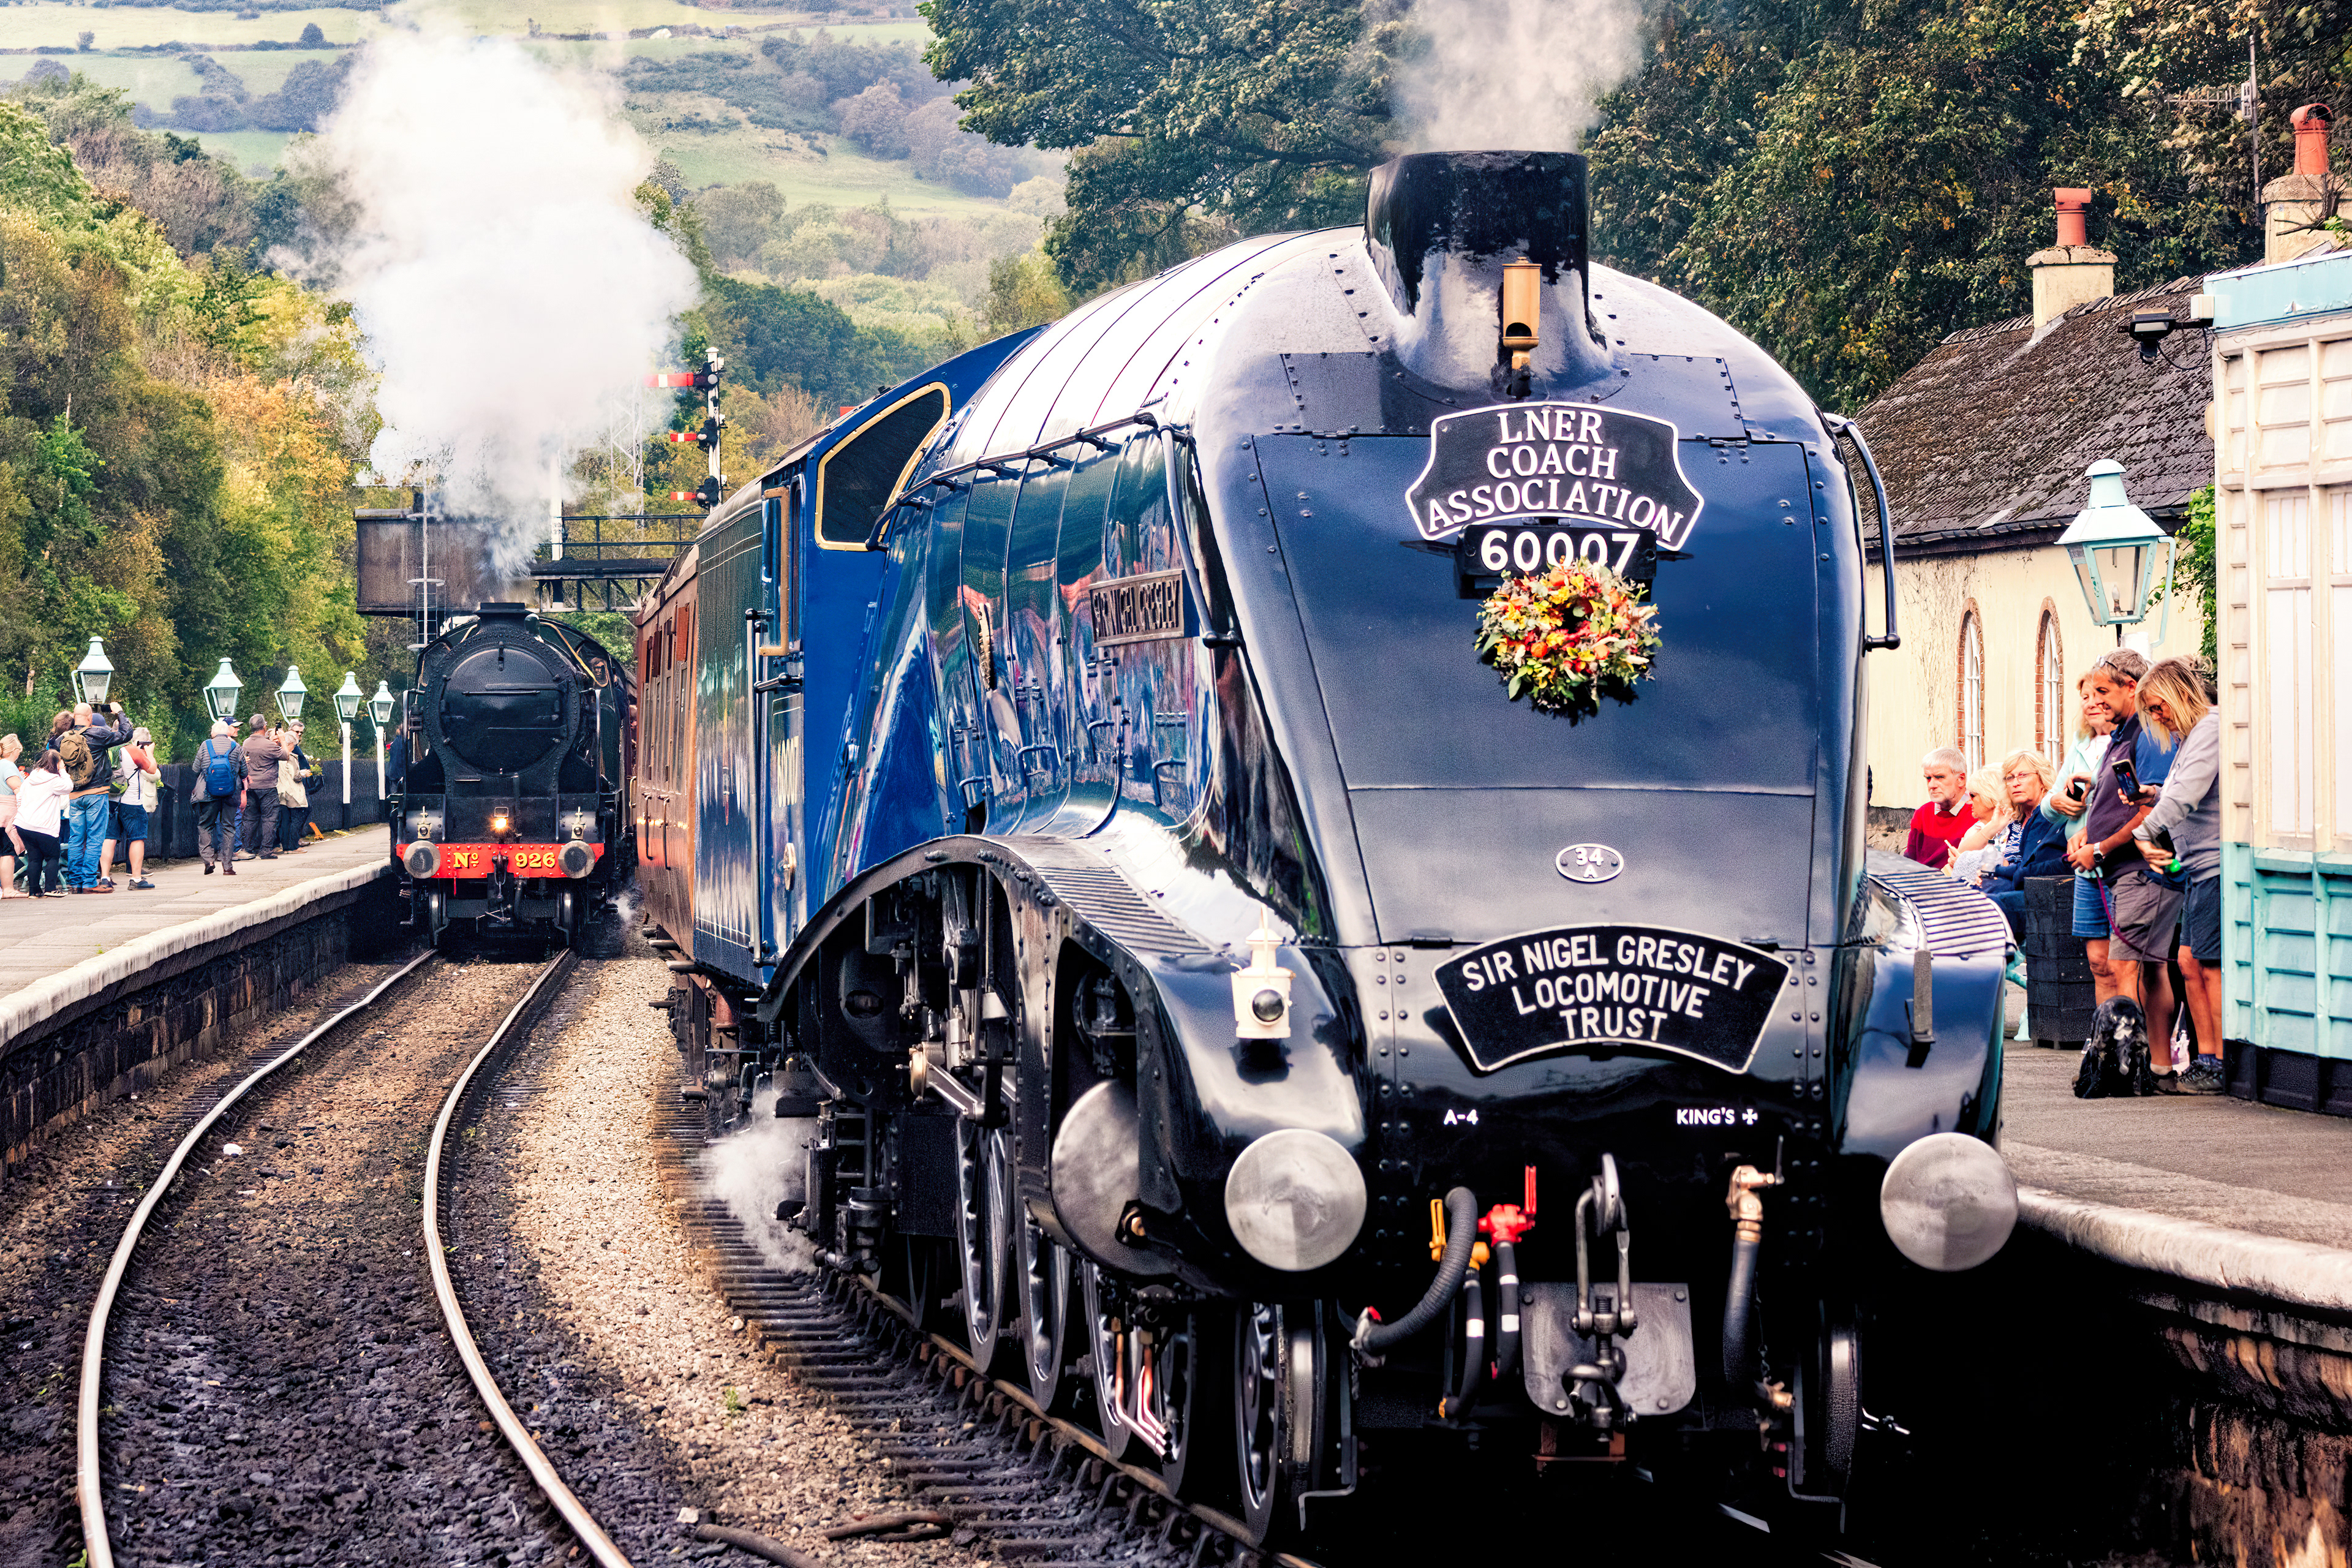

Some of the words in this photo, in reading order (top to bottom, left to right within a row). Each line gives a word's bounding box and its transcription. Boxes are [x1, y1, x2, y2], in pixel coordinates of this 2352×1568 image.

[1497, 409, 1604, 445] LNER
[1487, 443, 1618, 480] COACH
[1428, 479, 1684, 542] ASSOCIATION
[1480, 530, 1640, 574] 60007
[777, 735, 799, 808] 60007
[514, 853, 556, 869] 926
[1575, 847, 1604, 866] 34
[1583, 864, 1598, 878] A
[1463, 951, 1518, 992] SIR
[1521, 935, 1608, 975] NIGEL
[1617, 935, 1755, 991] GRESLEY
[1511, 971, 1710, 1019] LOCOMOTIVE
[1559, 1007, 1667, 1041] TRUST
[1443, 1109, 1479, 1126] A-4
[1676, 1107, 1735, 1125] KING'S
